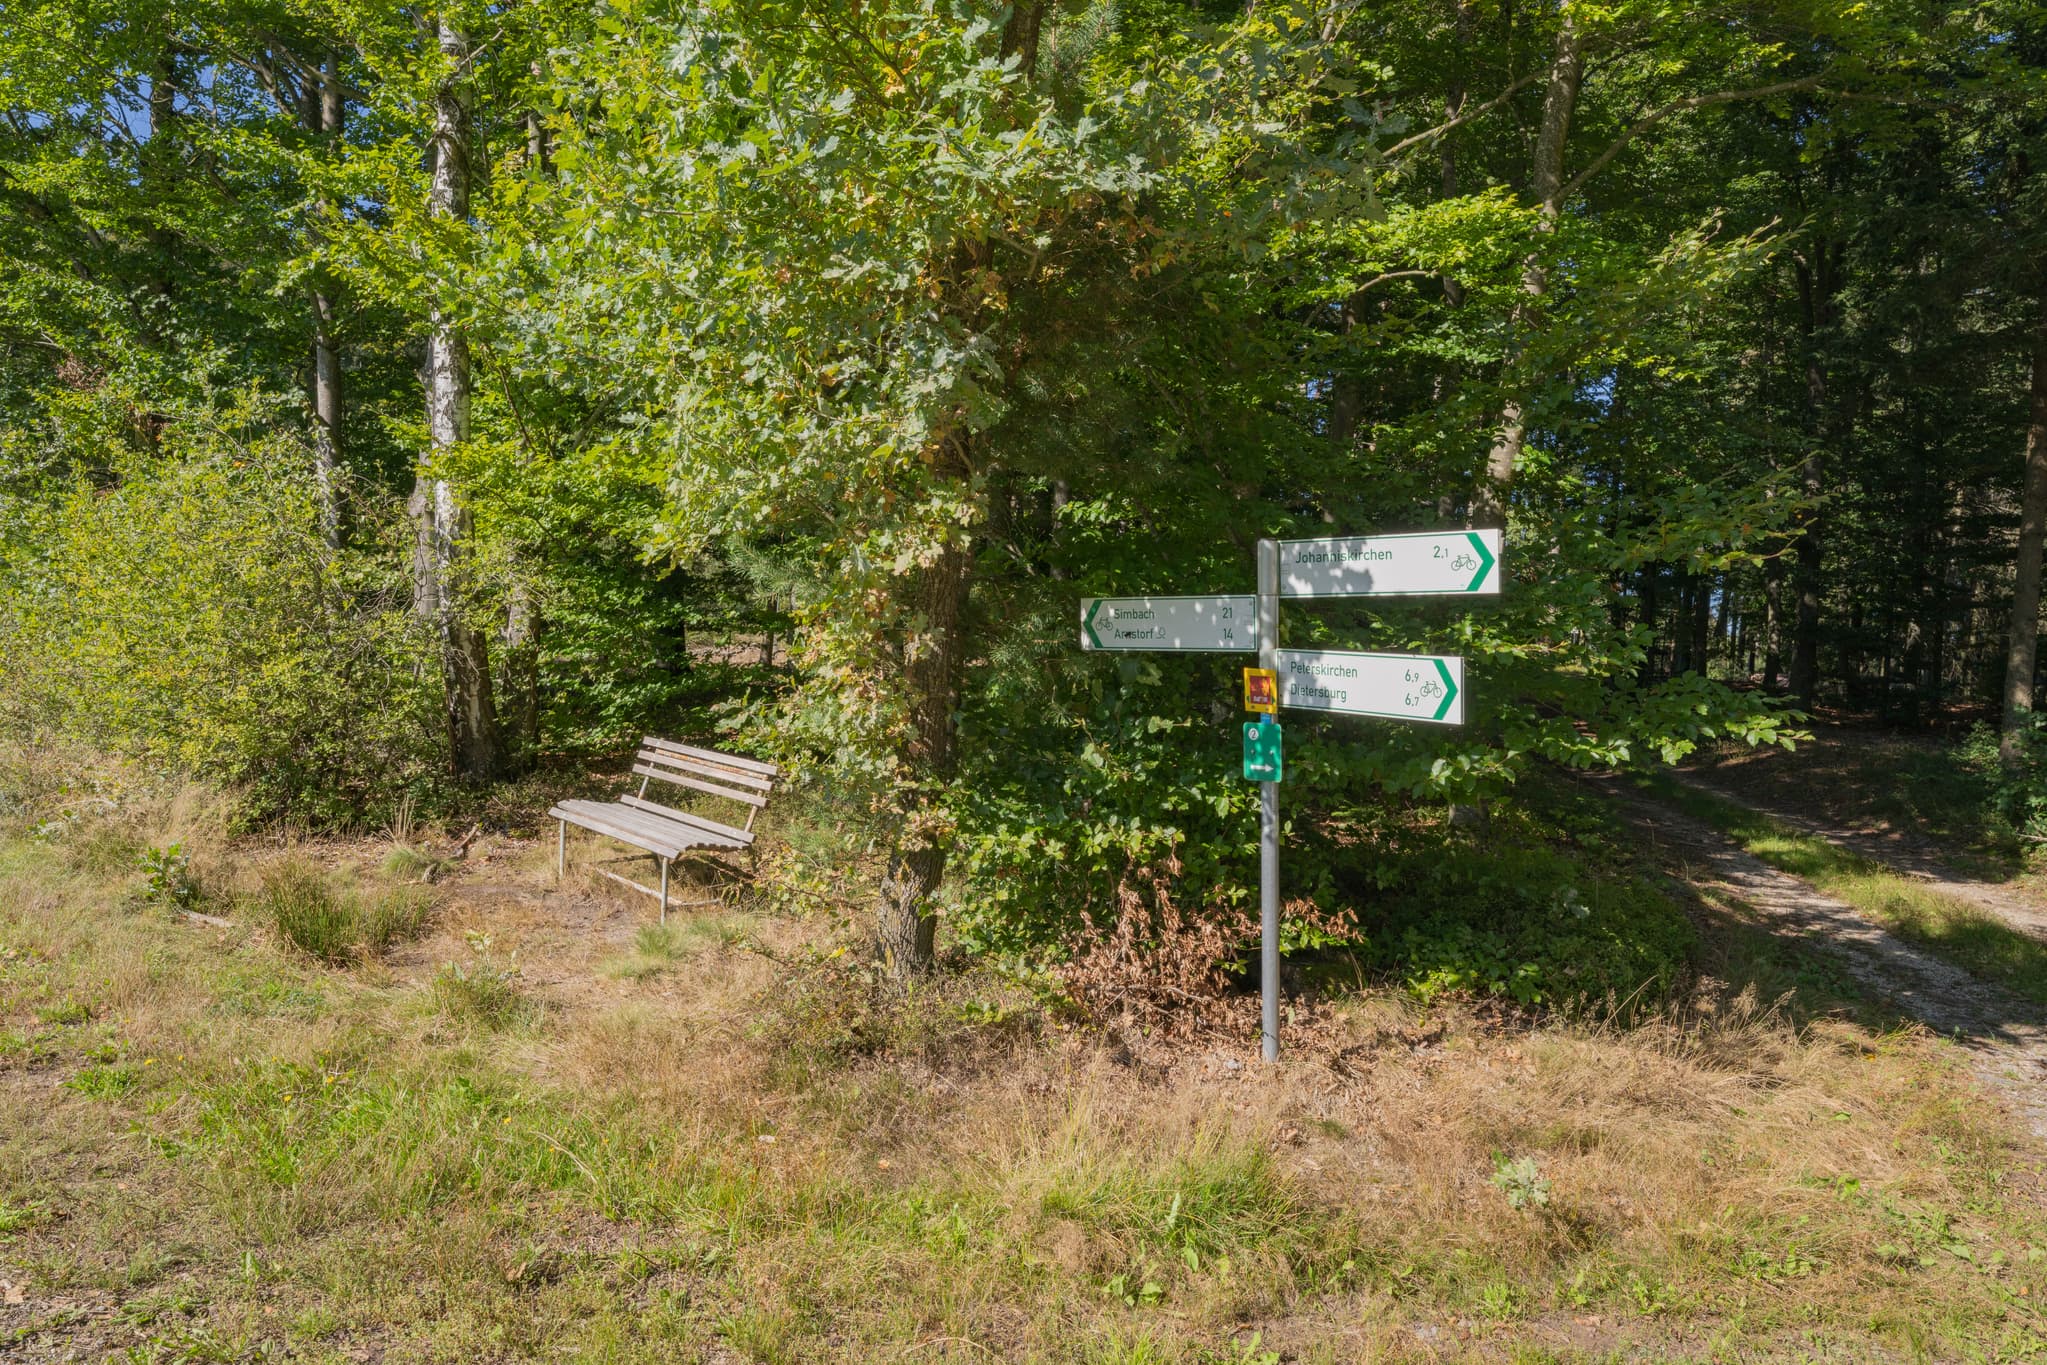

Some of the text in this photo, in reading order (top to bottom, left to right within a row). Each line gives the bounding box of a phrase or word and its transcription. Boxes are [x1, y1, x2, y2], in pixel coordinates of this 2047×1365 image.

[1295, 548, 1393, 564] Johanniskirchen
[1113, 607, 1233, 620] Simbach 21
[1223, 628, 1233, 640] 14
[1290, 661, 1358, 678] Peterskirchen
[1290, 683, 1347, 703] Dietersburg
